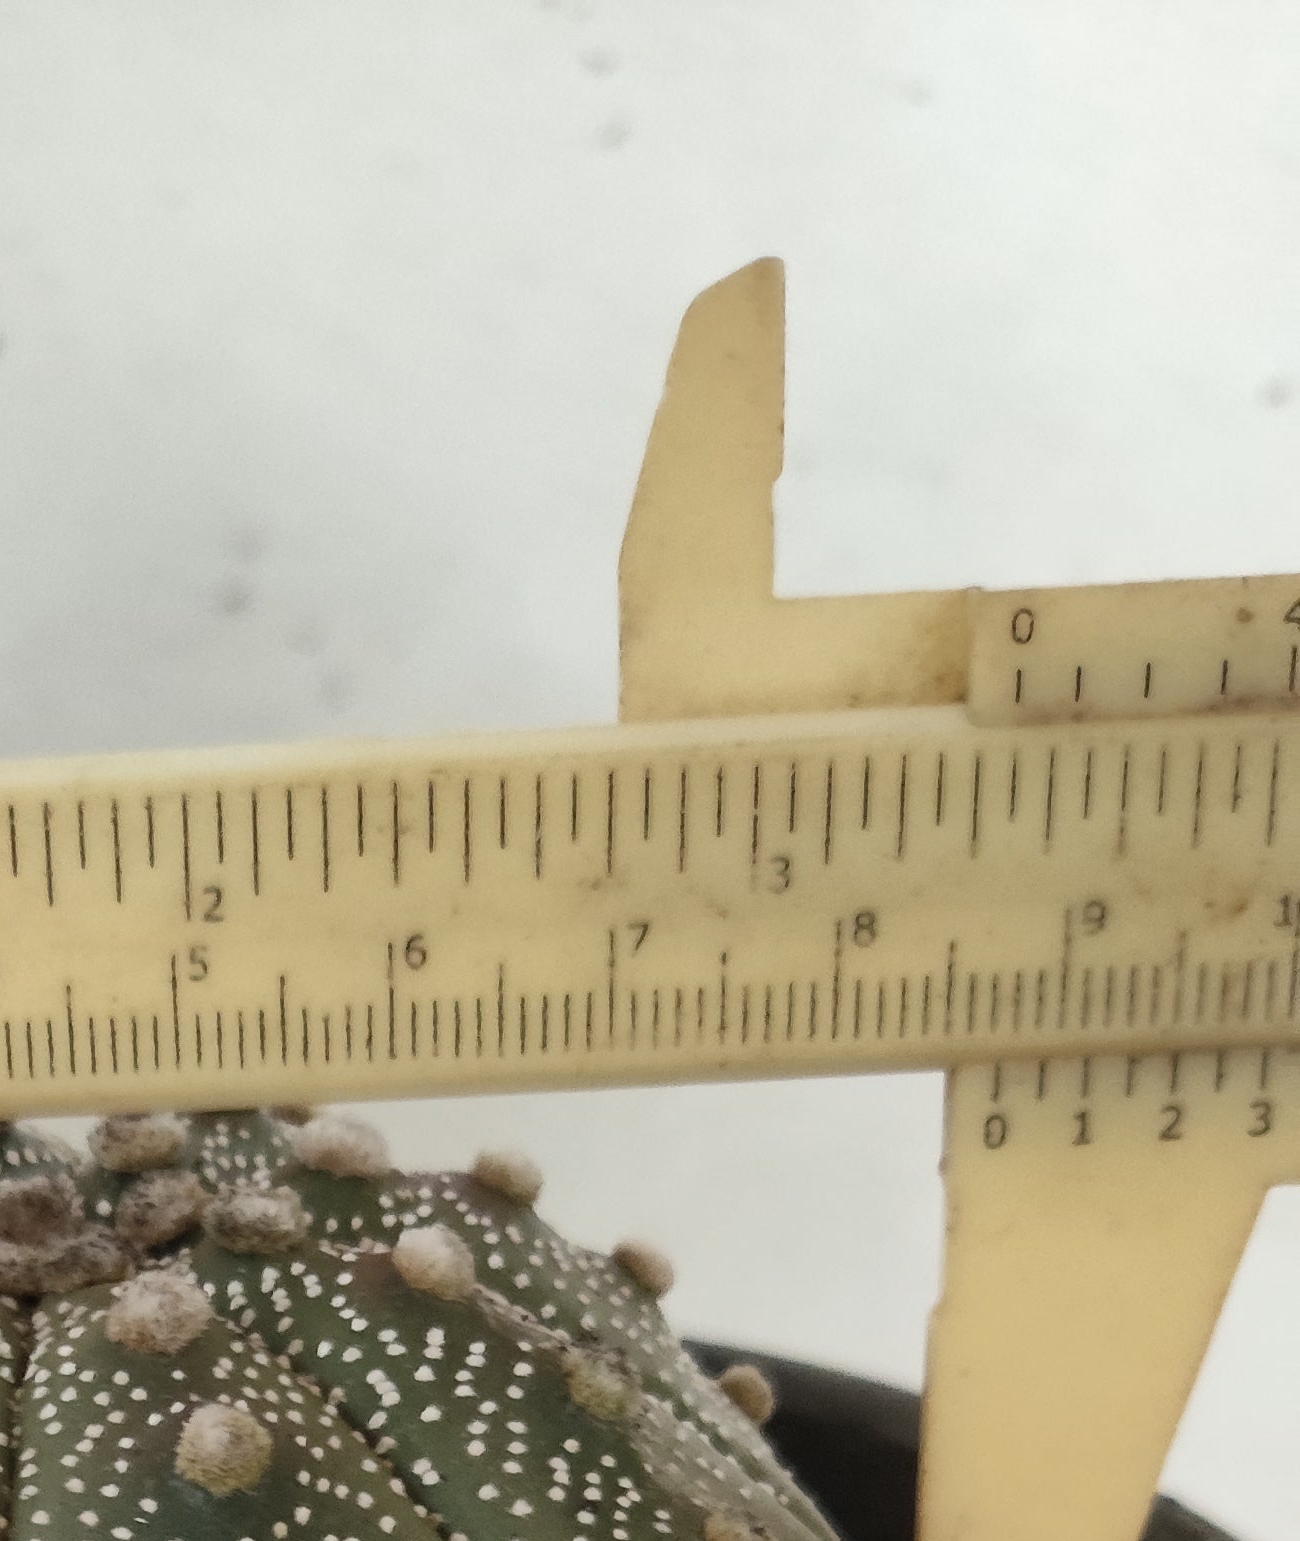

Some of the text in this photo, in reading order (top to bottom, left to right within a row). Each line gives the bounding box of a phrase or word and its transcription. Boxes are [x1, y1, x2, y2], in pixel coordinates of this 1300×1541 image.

[1011, 607, 1035, 644] 0
[202, 886, 224, 922] 2
[769, 856, 791, 894] 3
[188, 946, 209, 981] 5
[405, 934, 427, 970] 6
[628, 921, 650, 955] 7
[852, 911, 877, 947] 8
[1083, 900, 1108, 937] 9
[983, 1101, 1272, 1149] 0 1 2 3
